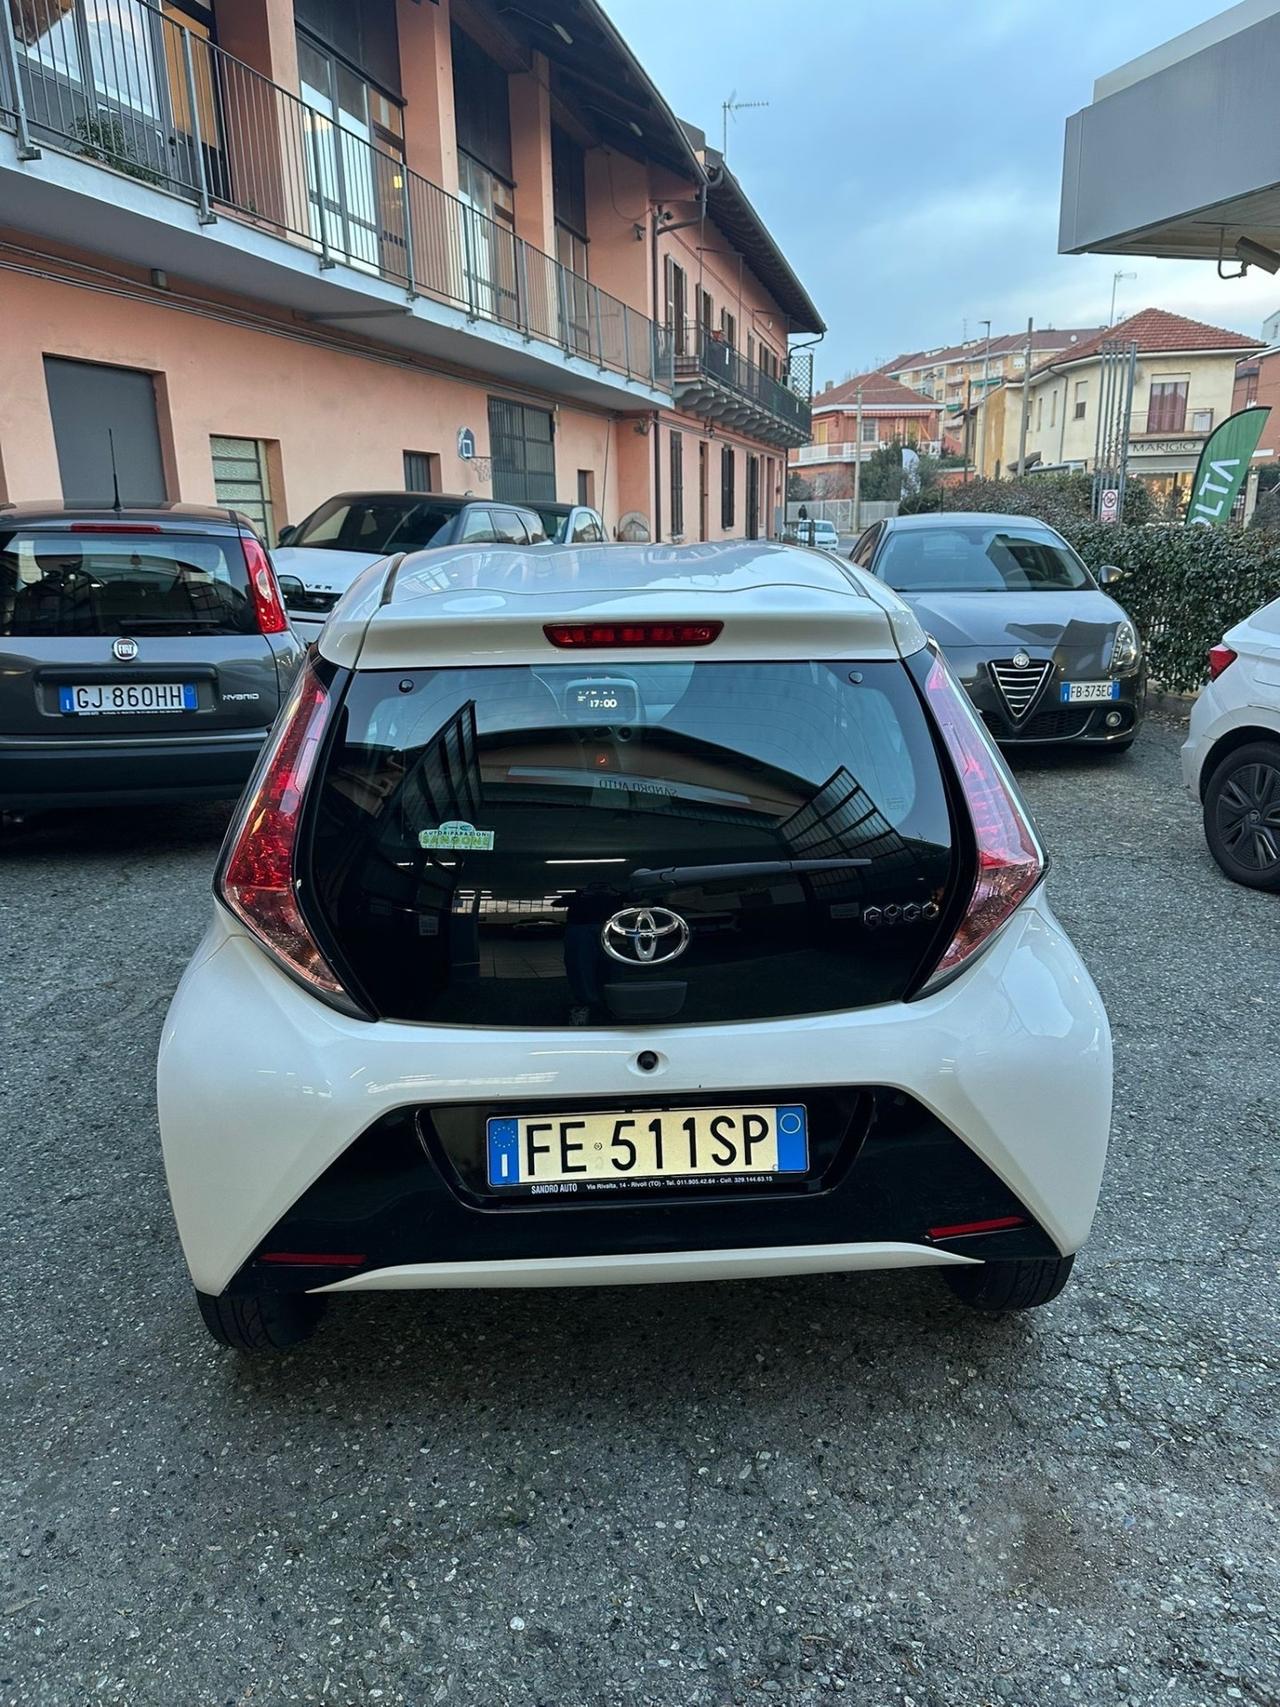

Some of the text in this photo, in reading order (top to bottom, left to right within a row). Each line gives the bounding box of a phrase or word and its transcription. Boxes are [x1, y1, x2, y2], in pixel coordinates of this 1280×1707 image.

[76, 686, 182, 709] GJ 860HH
[590, 699, 617, 708] 17:00
[526, 1113, 769, 1176] FE 511SP
[531, 1183, 578, 1194] SANDRO AUTO
